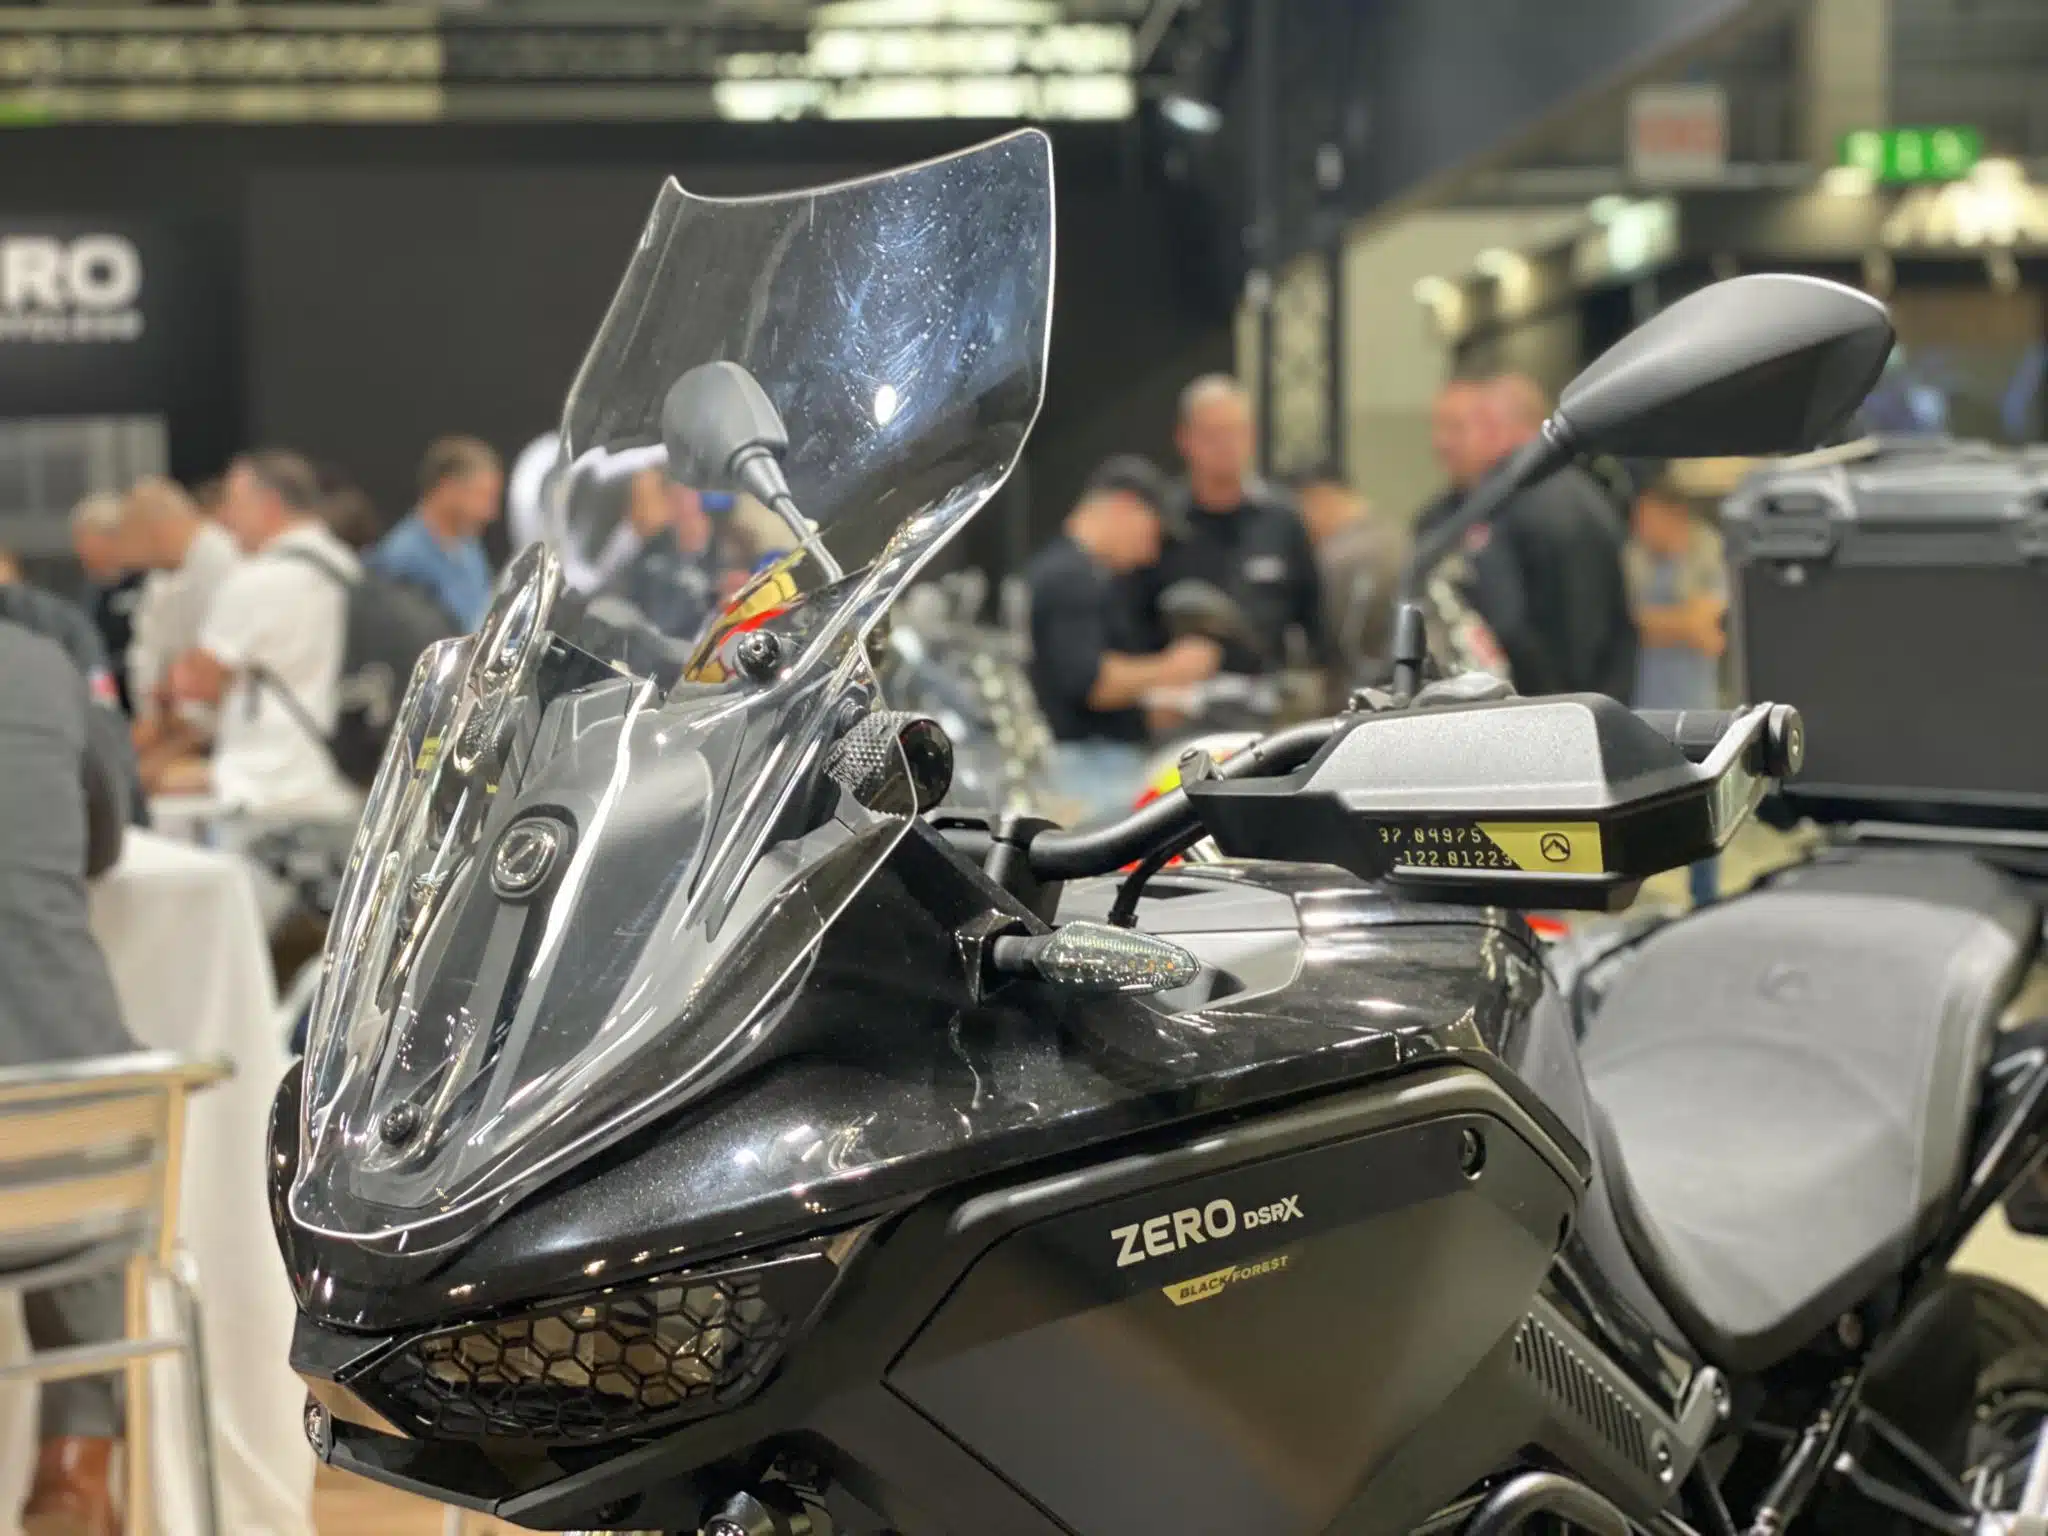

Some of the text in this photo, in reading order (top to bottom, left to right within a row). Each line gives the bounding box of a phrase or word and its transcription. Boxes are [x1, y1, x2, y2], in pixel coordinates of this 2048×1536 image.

[1111, 1194, 1304, 1267] ZERO DSRX
[1179, 1255, 1289, 1299] BLACK FOREST
